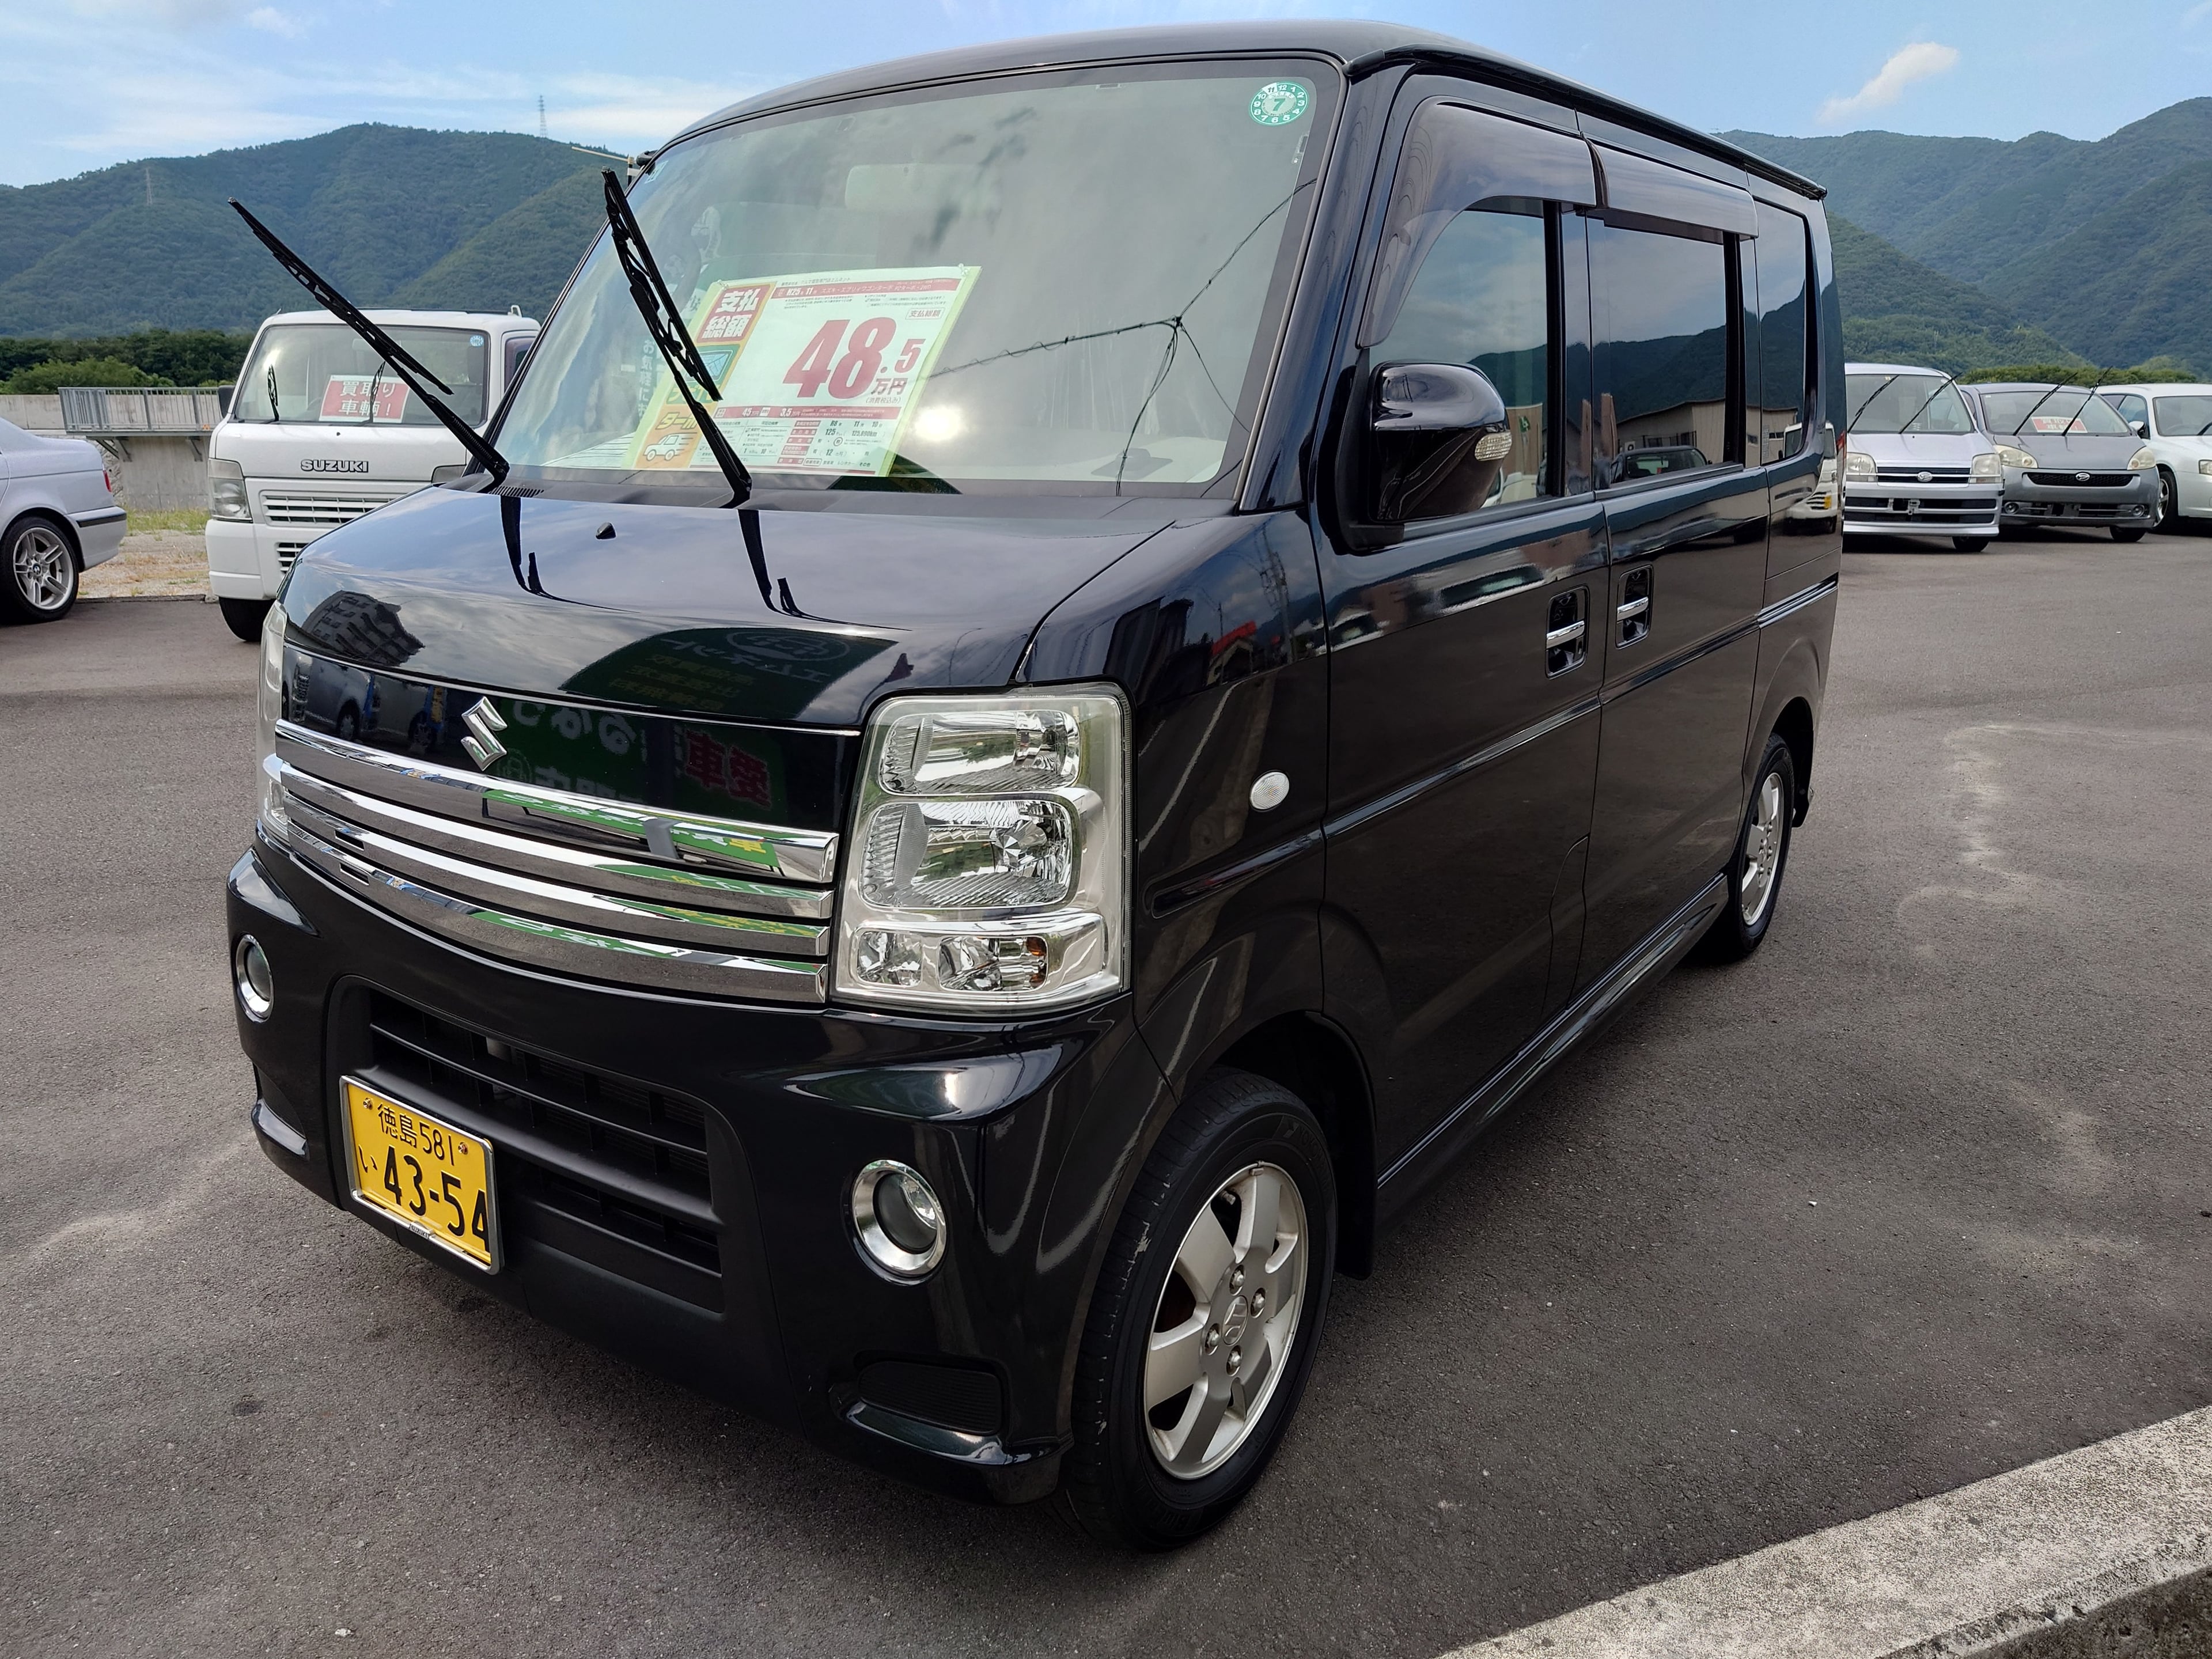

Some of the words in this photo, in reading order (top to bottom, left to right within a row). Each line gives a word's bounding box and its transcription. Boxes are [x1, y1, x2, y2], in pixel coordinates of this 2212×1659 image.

[1272, 98, 1286, 111] 7
[715, 288, 761, 313] 支払
[702, 314, 752, 339] 総額
[340, 381, 396, 397] 買取り
[871, 378, 908, 395] 万円
[301, 459, 369, 473] SUZUKI
[377, 1103, 417, 1149] 徳島
[419, 1120, 454, 1167] 581
[358, 1144, 378, 1173] い
[384, 1144, 490, 1253] 43-54
